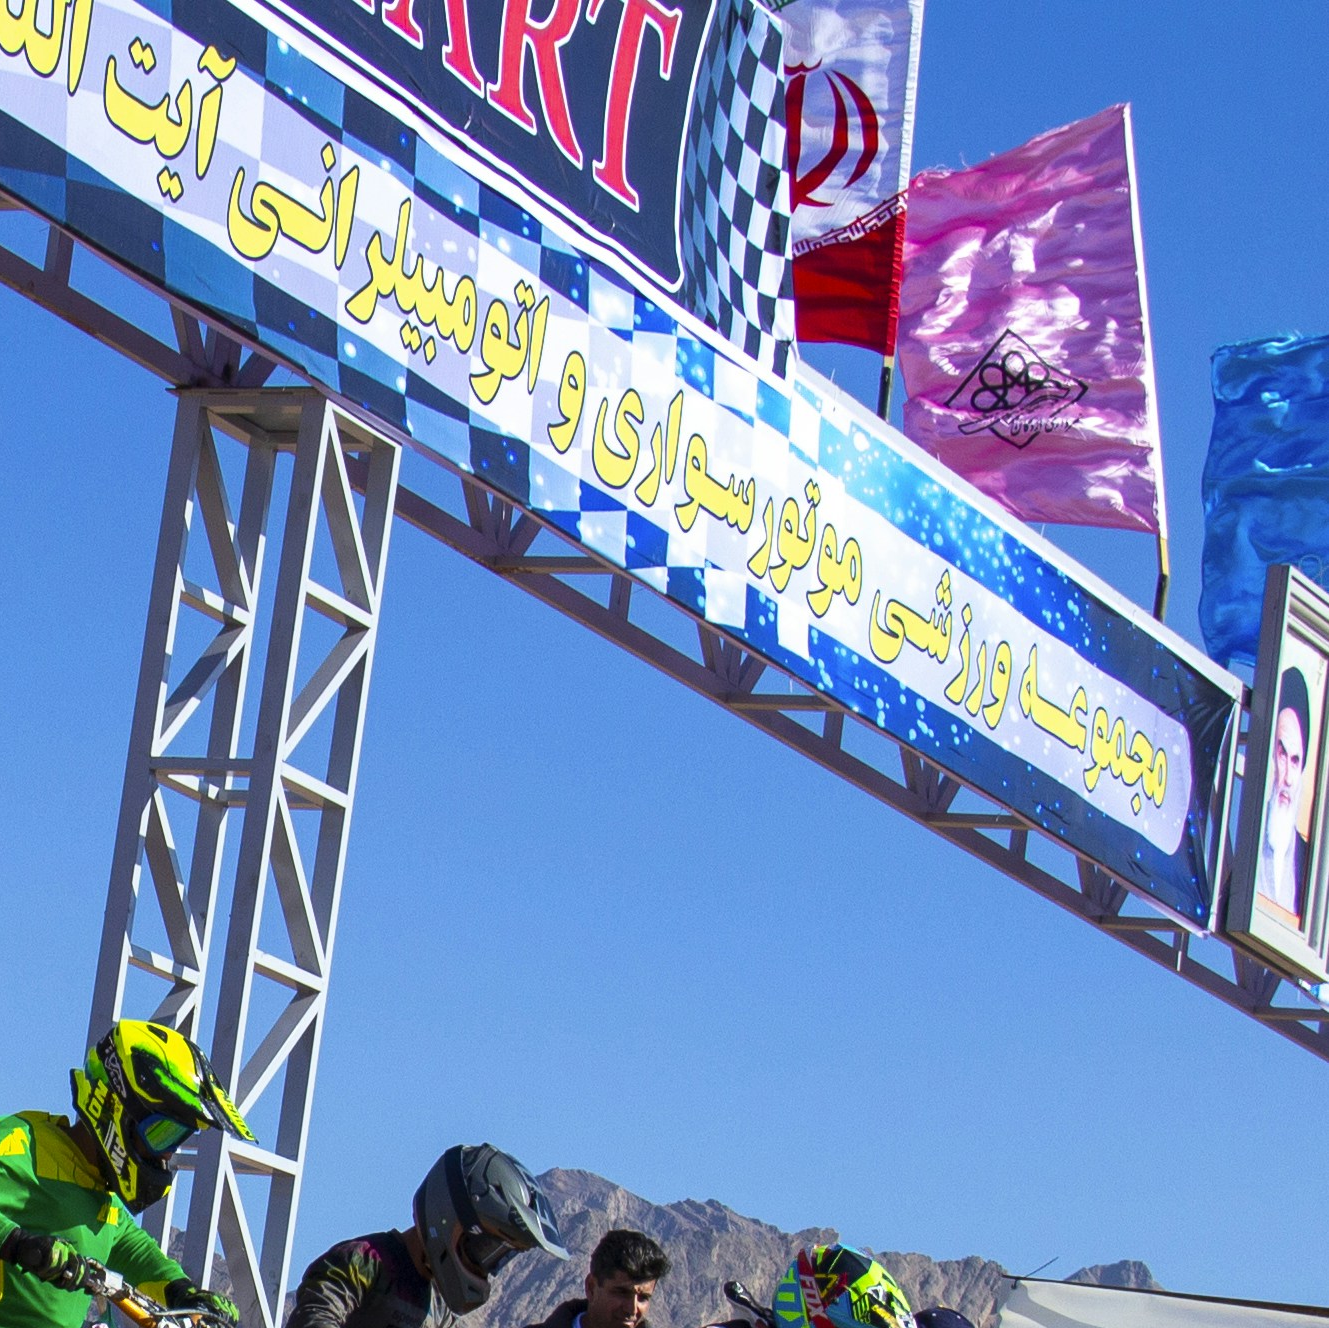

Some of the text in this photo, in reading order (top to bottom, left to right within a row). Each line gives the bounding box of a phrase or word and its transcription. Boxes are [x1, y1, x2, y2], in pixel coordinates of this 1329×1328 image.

[103, 44, 237, 203] آیت
[381, 0, 683, 212] ART
[547, 350, 586, 454] و
[869, 568, 1013, 730] ورزشی
[1018, 643, 1167, 816] مجموعه
[799, 1274, 829, 1320] FOX
